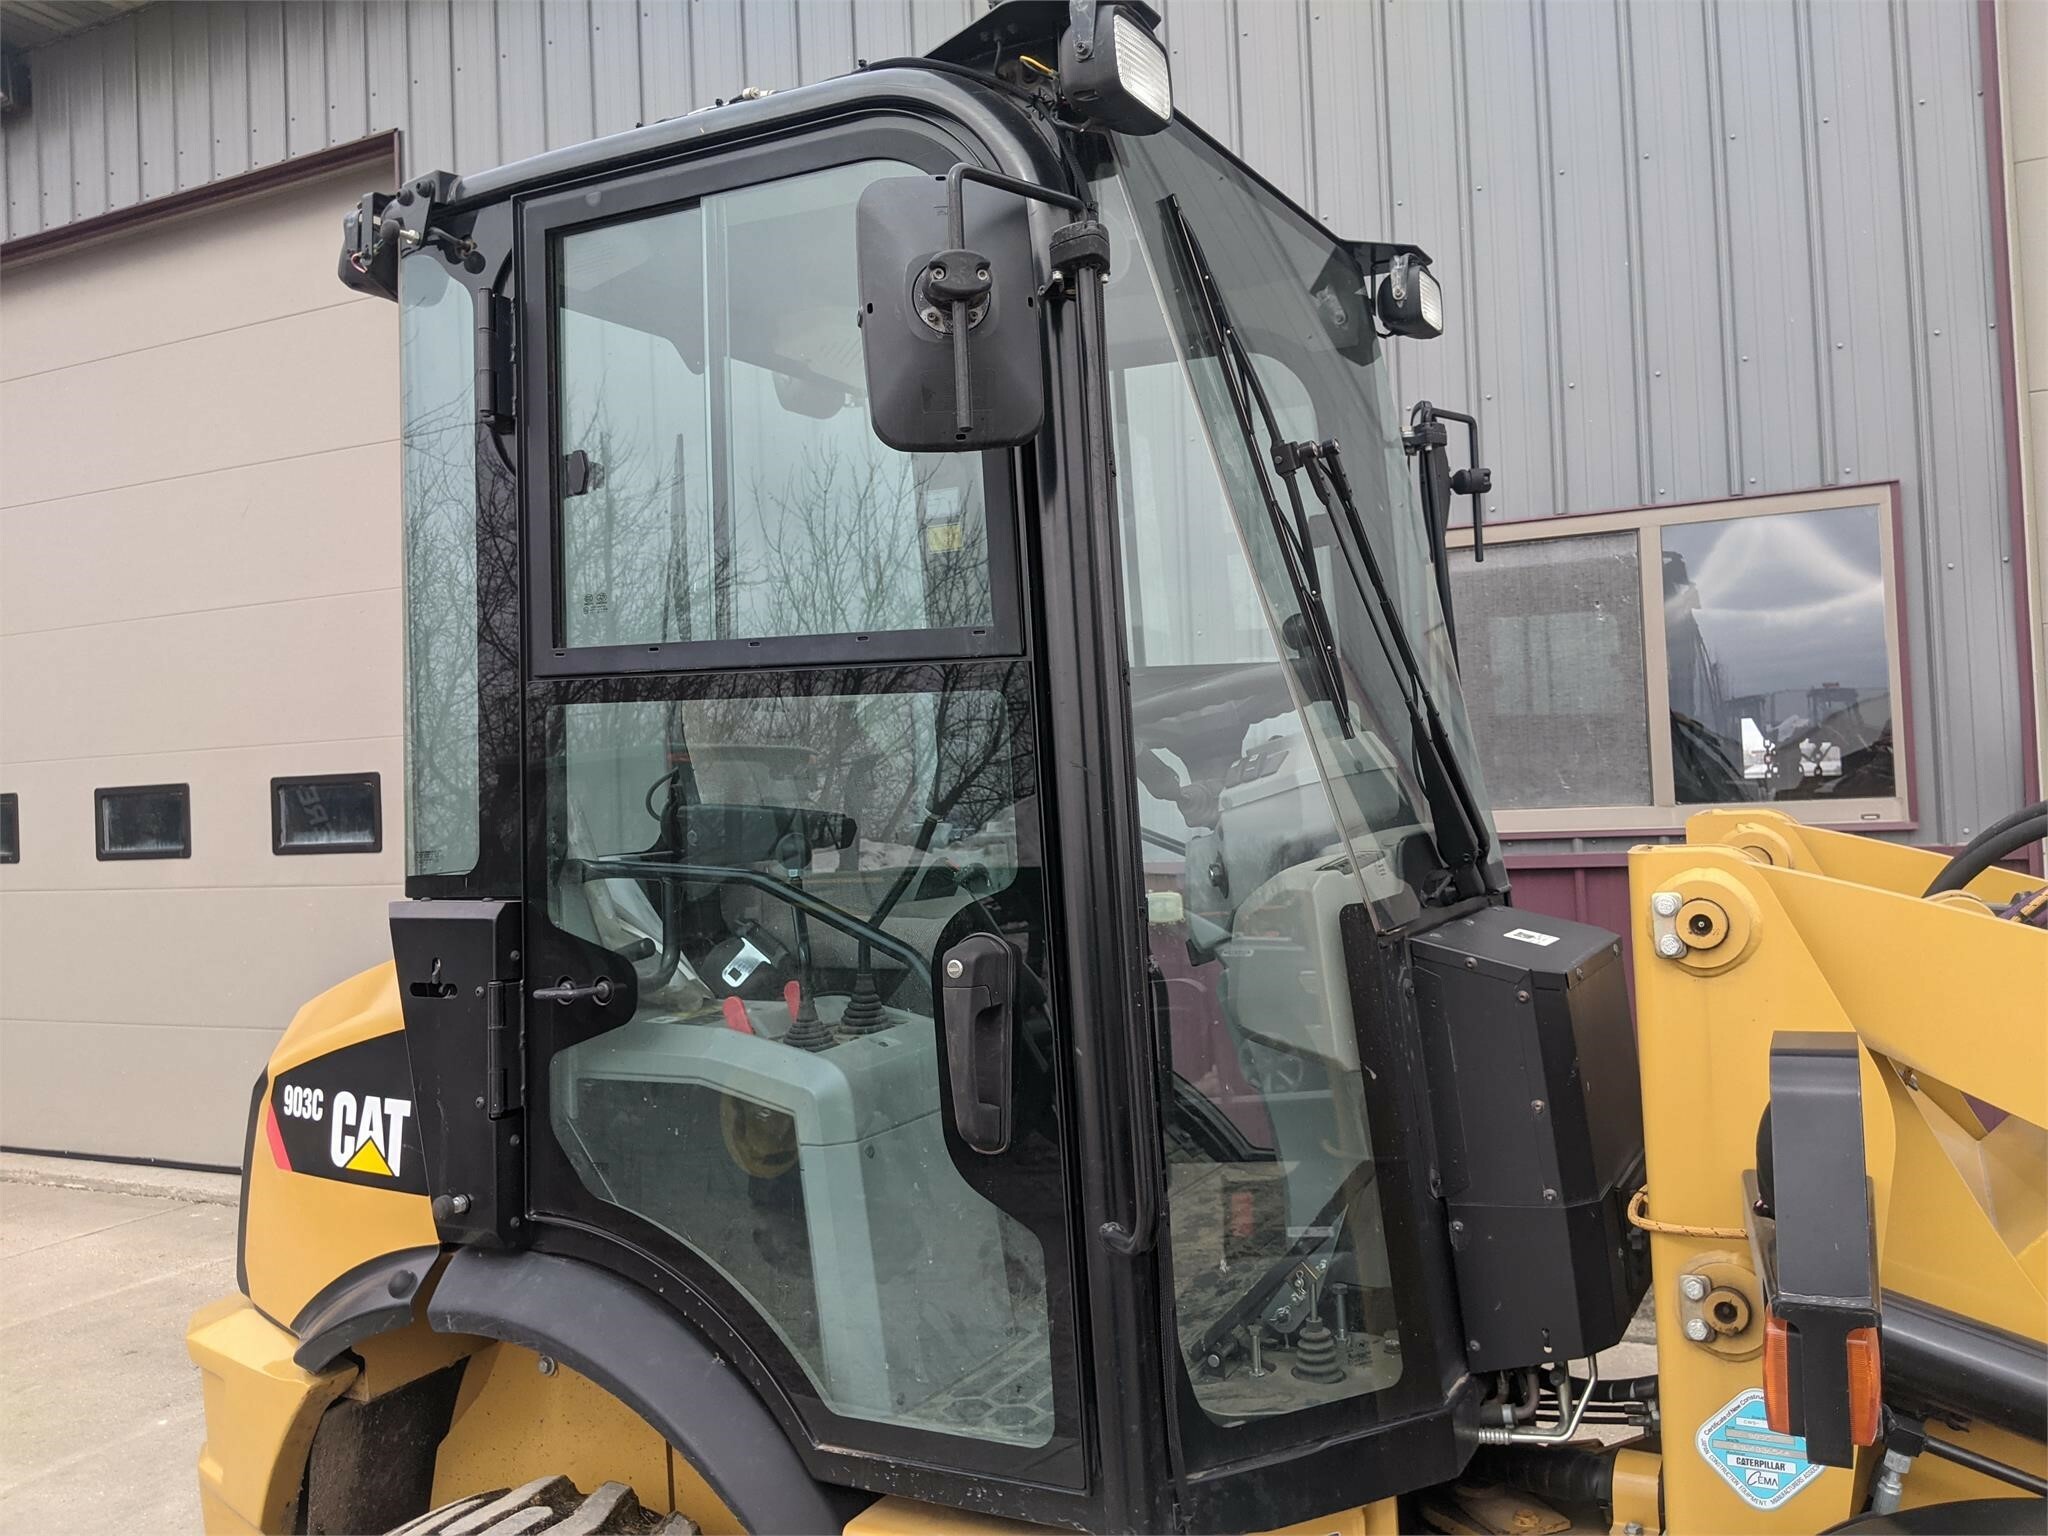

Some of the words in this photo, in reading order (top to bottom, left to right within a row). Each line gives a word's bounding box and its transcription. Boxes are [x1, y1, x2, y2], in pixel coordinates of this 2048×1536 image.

[284, 1084, 324, 1121] 903C
[331, 1091, 412, 1177] CAT
[1703, 1415, 1727, 1436] Certificate
[1730, 1404, 1741, 1414] New
[1709, 1454, 1740, 1486] CONSTRUCTION
[1739, 1484, 1767, 1506] EQUIPMENT
[1770, 1476, 1804, 1504] MANUFACTURERS
[1736, 1456, 1786, 1471] CATERPILLAR
